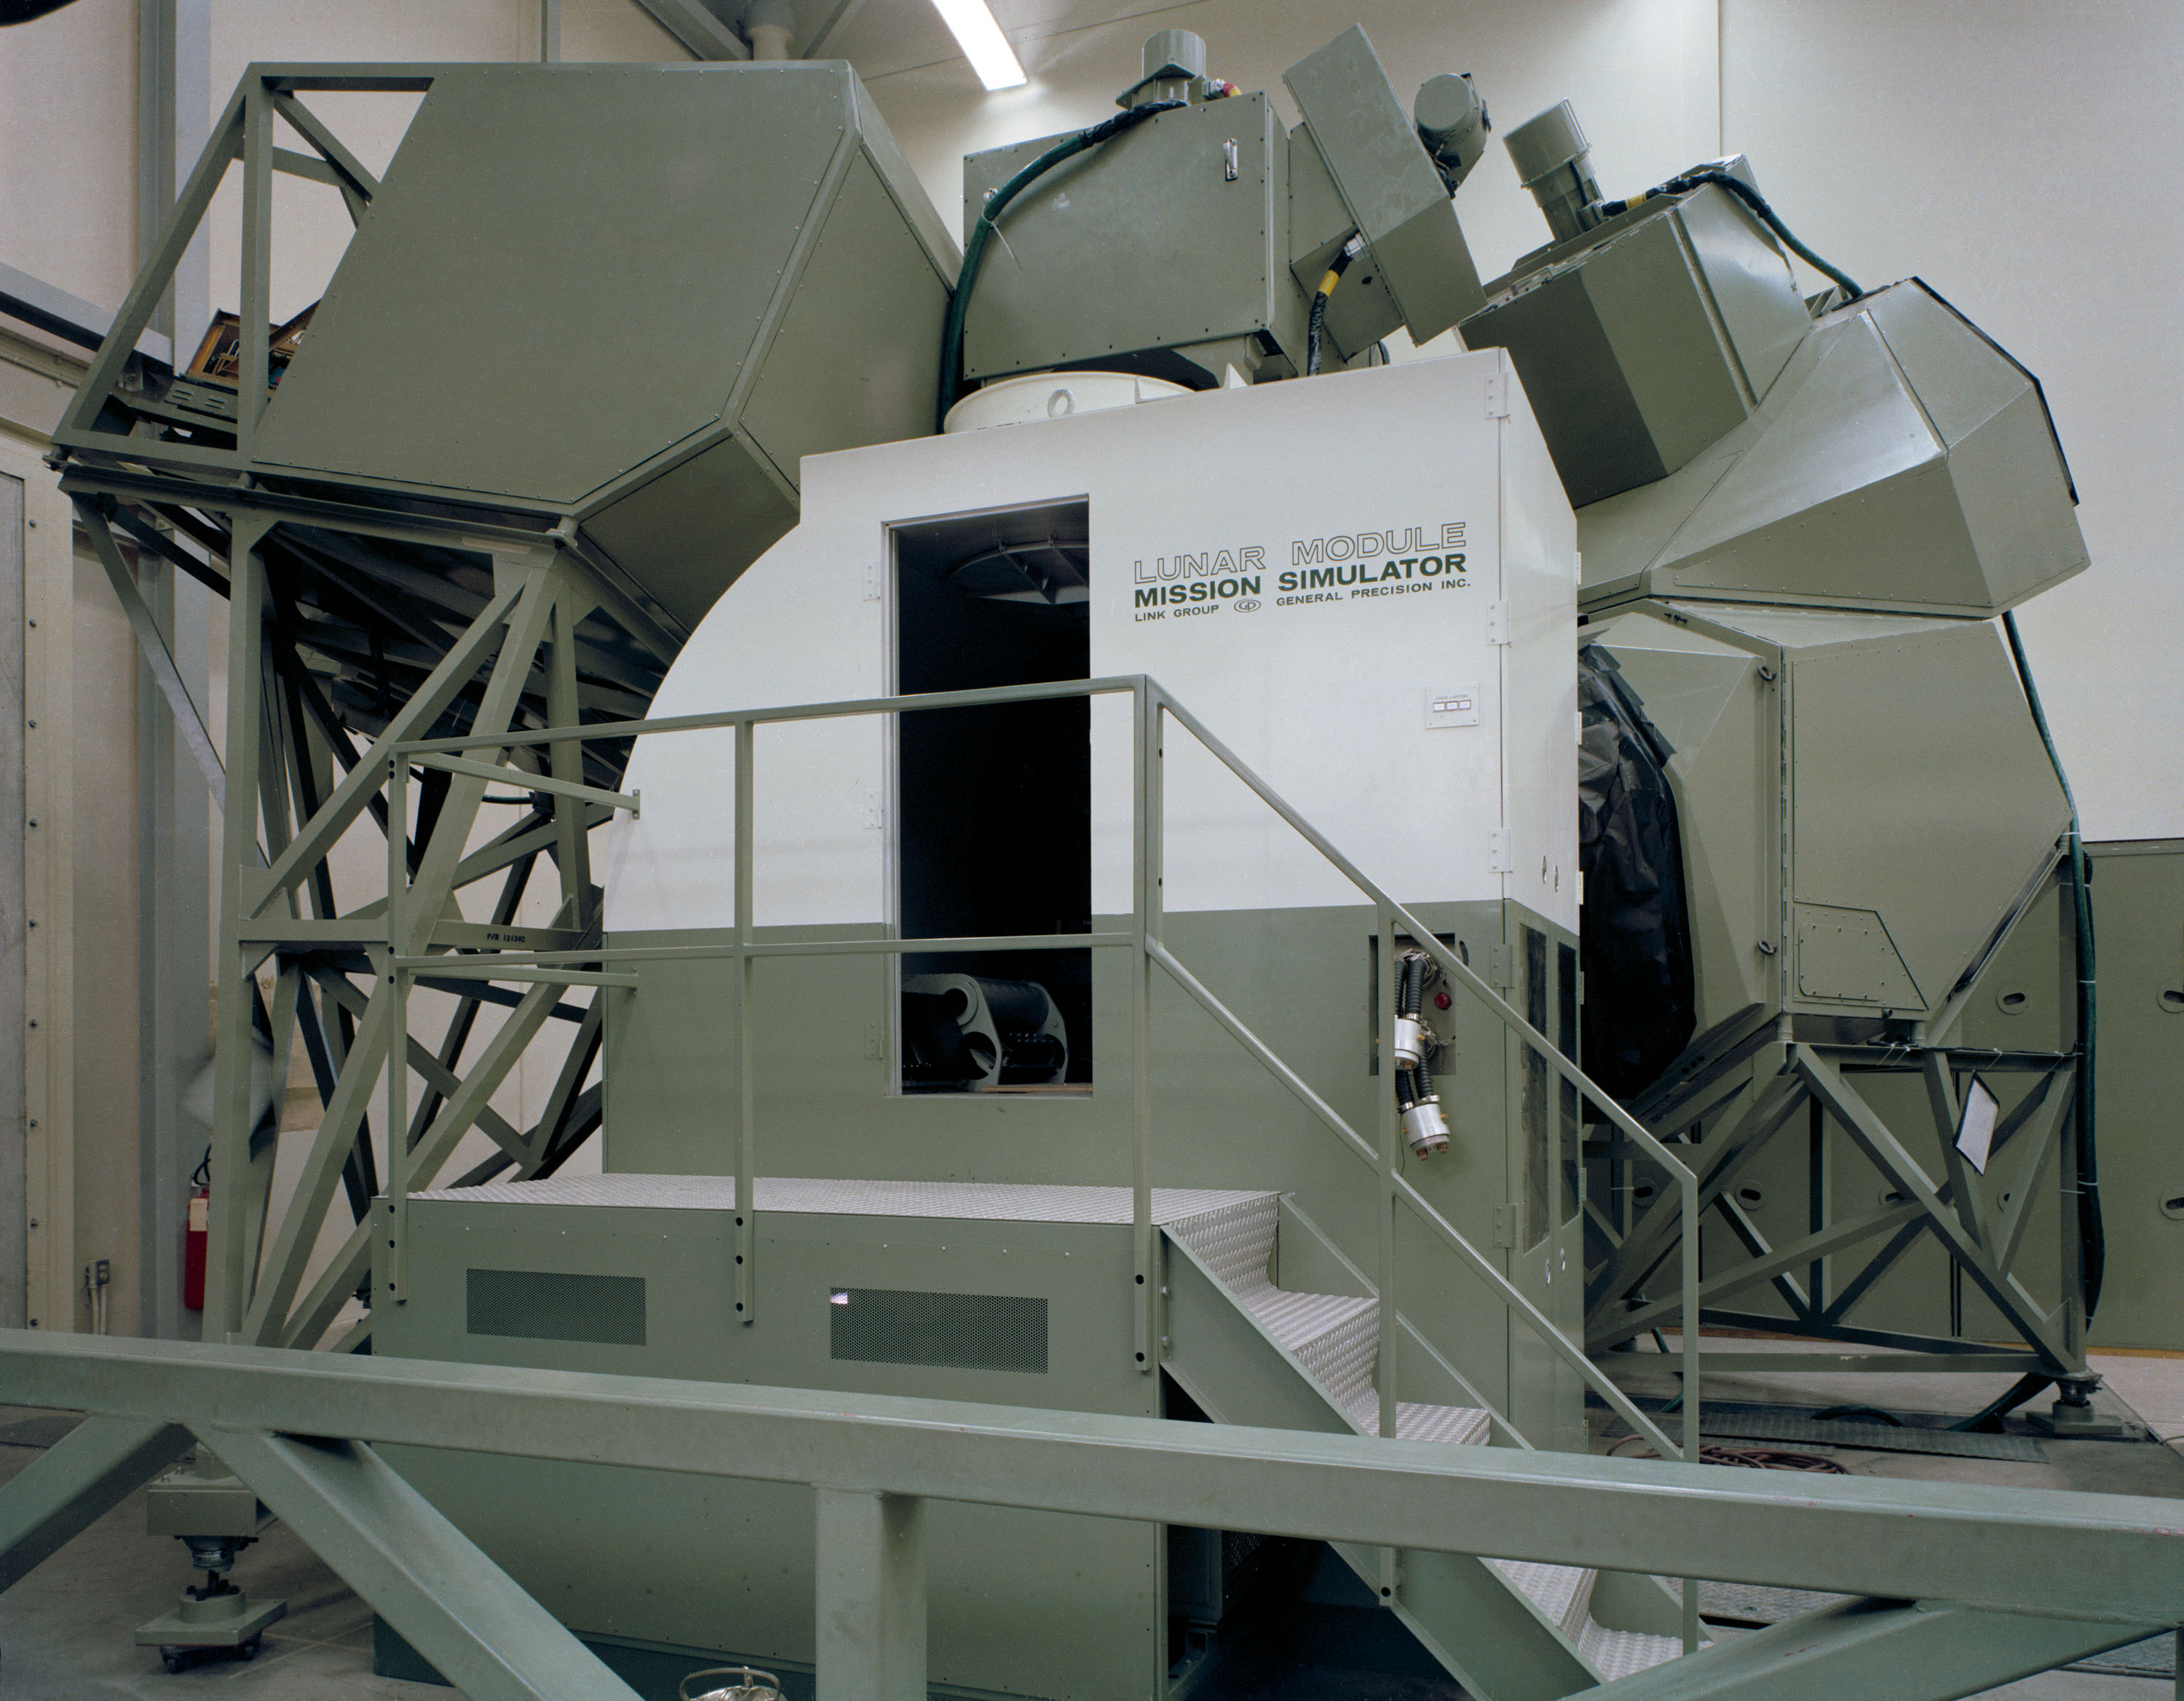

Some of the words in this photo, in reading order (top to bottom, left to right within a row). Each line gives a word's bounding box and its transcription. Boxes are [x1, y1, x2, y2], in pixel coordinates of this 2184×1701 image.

[1134, 546, 1267, 585] LUNAR
[1291, 522, 1467, 567] MODULE
[1134, 576, 1261, 609] MISSION
[1278, 553, 1468, 592] SIMULATOR
[1134, 611, 1166, 623] LINK
[1174, 605, 1219, 618] GROUP
[1276, 591, 1344, 607] GENERAL
[1351, 580, 1433, 599] PRECISION
[1441, 578, 1471, 590] INC.
